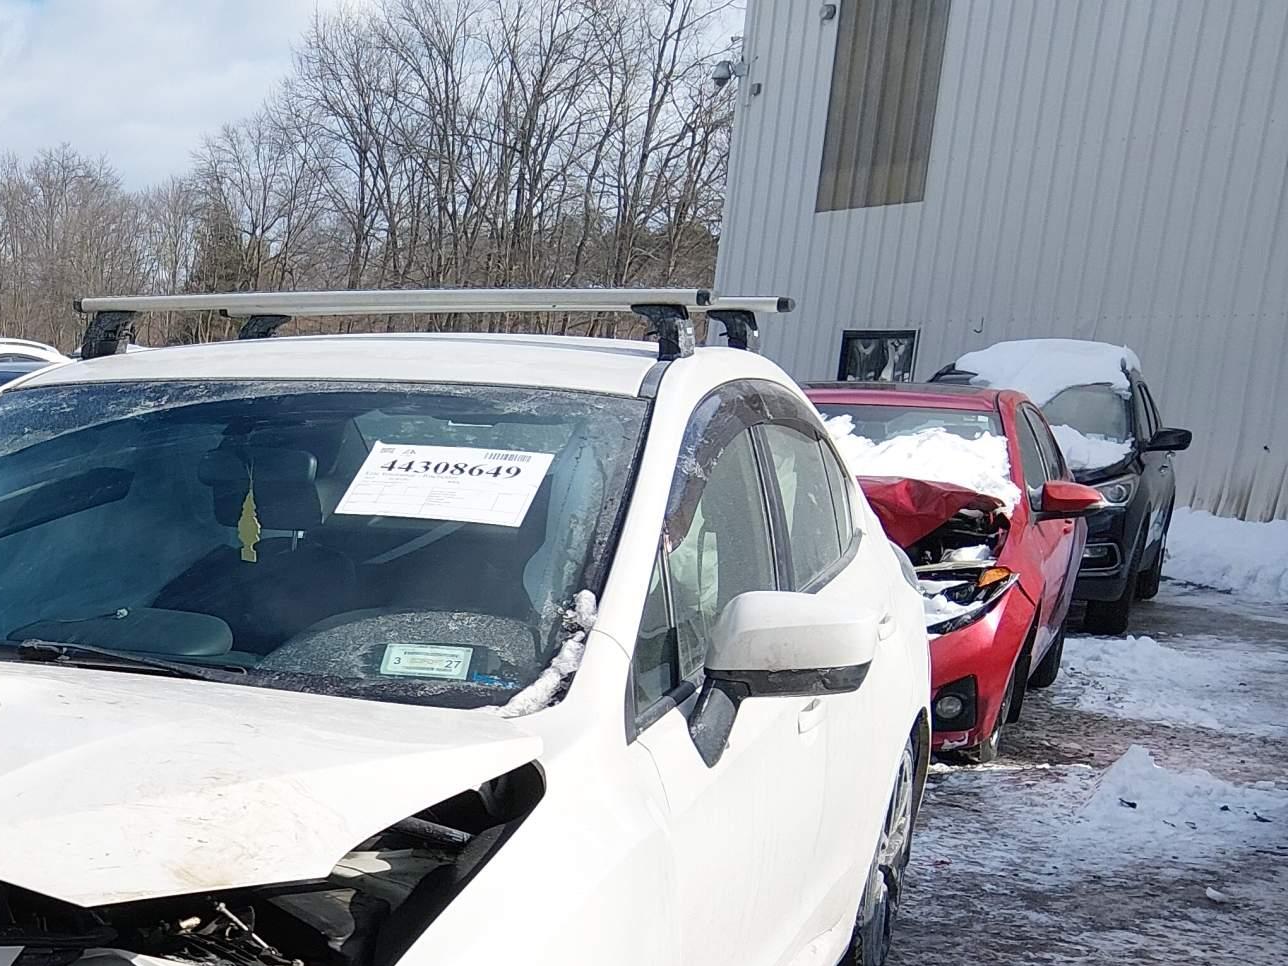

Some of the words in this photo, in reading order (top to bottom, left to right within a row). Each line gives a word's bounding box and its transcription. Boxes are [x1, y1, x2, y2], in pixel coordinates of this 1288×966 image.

[380, 459, 522, 479] 44308649
[393, 656, 402, 665] 3
[444, 659, 462, 669] 27
